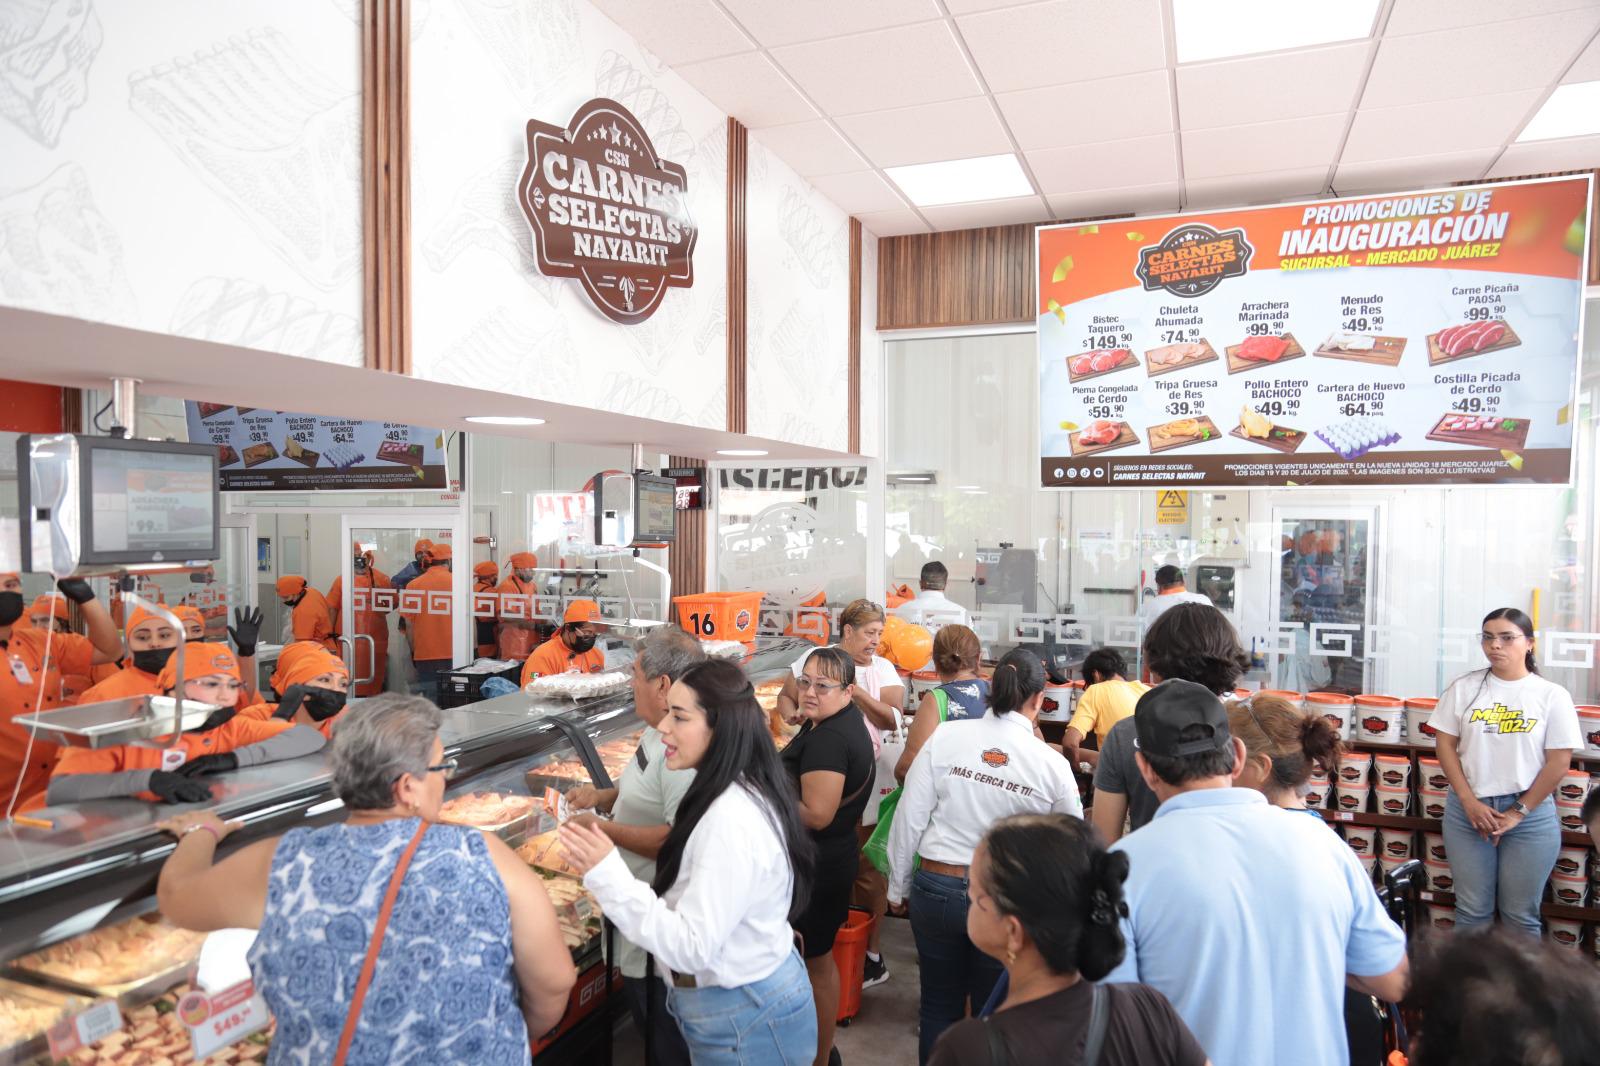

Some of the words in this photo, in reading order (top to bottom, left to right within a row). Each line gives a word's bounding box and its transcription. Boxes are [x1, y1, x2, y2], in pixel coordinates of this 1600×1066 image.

[604, 148, 630, 168] CSN
[542, 151, 682, 216] CARNES
[1302, 191, 1456, 226] PROMOCIONES
[1460, 190, 1493, 212] DE
[548, 193, 682, 244] SELECTAS
[1278, 206, 1510, 257] INAUGURACIÓN
[572, 232, 669, 267] NAYARIT
[1148, 239, 1235, 265] CARNES
[1149, 251, 1236, 275] SELECTAS
[1279, 256, 1351, 272] SUCURSAL
[1366, 247, 1438, 266] MERCADO
[1441, 242, 1500, 260] JUÁREZ
[1160, 264, 1224, 283] NAYARIT
[1451, 286, 1482, 296] Carne
[1484, 283, 1519, 294] Picaña
[1241, 301, 1289, 311] Arrachera
[1340, 295, 1384, 306] Menudo
[1468, 295, 1502, 305] PAOSA
[1159, 305, 1199, 315] Chuleta
[1342, 306, 1356, 316] de
[1360, 305, 1382, 315] Res
[1093, 315, 1119, 324] Bistec
[1155, 316, 1203, 327] Ahumada
[1239, 311, 1289, 322] Marinada
[1088, 323, 1125, 335] Taquero
[1245, 380, 1272, 390] Pollo
[1274, 379, 1309, 389] Entero
[1434, 374, 1477, 385] Costilla
[1480, 372, 1521, 383] Picada
[1072, 385, 1096, 394] Pierna
[1098, 384, 1138, 395] Congelada
[1155, 380, 1180, 392] Tripa
[1182, 379, 1218, 389] Gruesa
[1317, 383, 1355, 393] Cartera
[1357, 382, 1370, 392] de
[1373, 381, 1406, 391] Huevo
[1450, 385, 1465, 395] de
[1467, 384, 1502, 394] Cerdo
[1083, 395, 1096, 404] de
[1098, 393, 1128, 404] Cerdo
[1168, 390, 1181, 399] de
[1183, 390, 1203, 399] Res
[1251, 389, 1302, 399] BACHOCO
[1337, 392, 1385, 402] BACHOCO
[1113, 472, 1140, 480] CARNES
[1142, 472, 1176, 480] SELECTAS
[1177, 472, 1206, 480] NAYARIT
[689, 612, 715, 635] 16
[1469, 708, 1523, 726] Mejor
[1498, 718, 1538, 734] 102.7
[949, 766, 973, 779] ¡MÁS
[974, 772, 1004, 788] CERCA
[1006, 781, 1019, 793] DE
[1020, 786, 1033, 797] TI!
